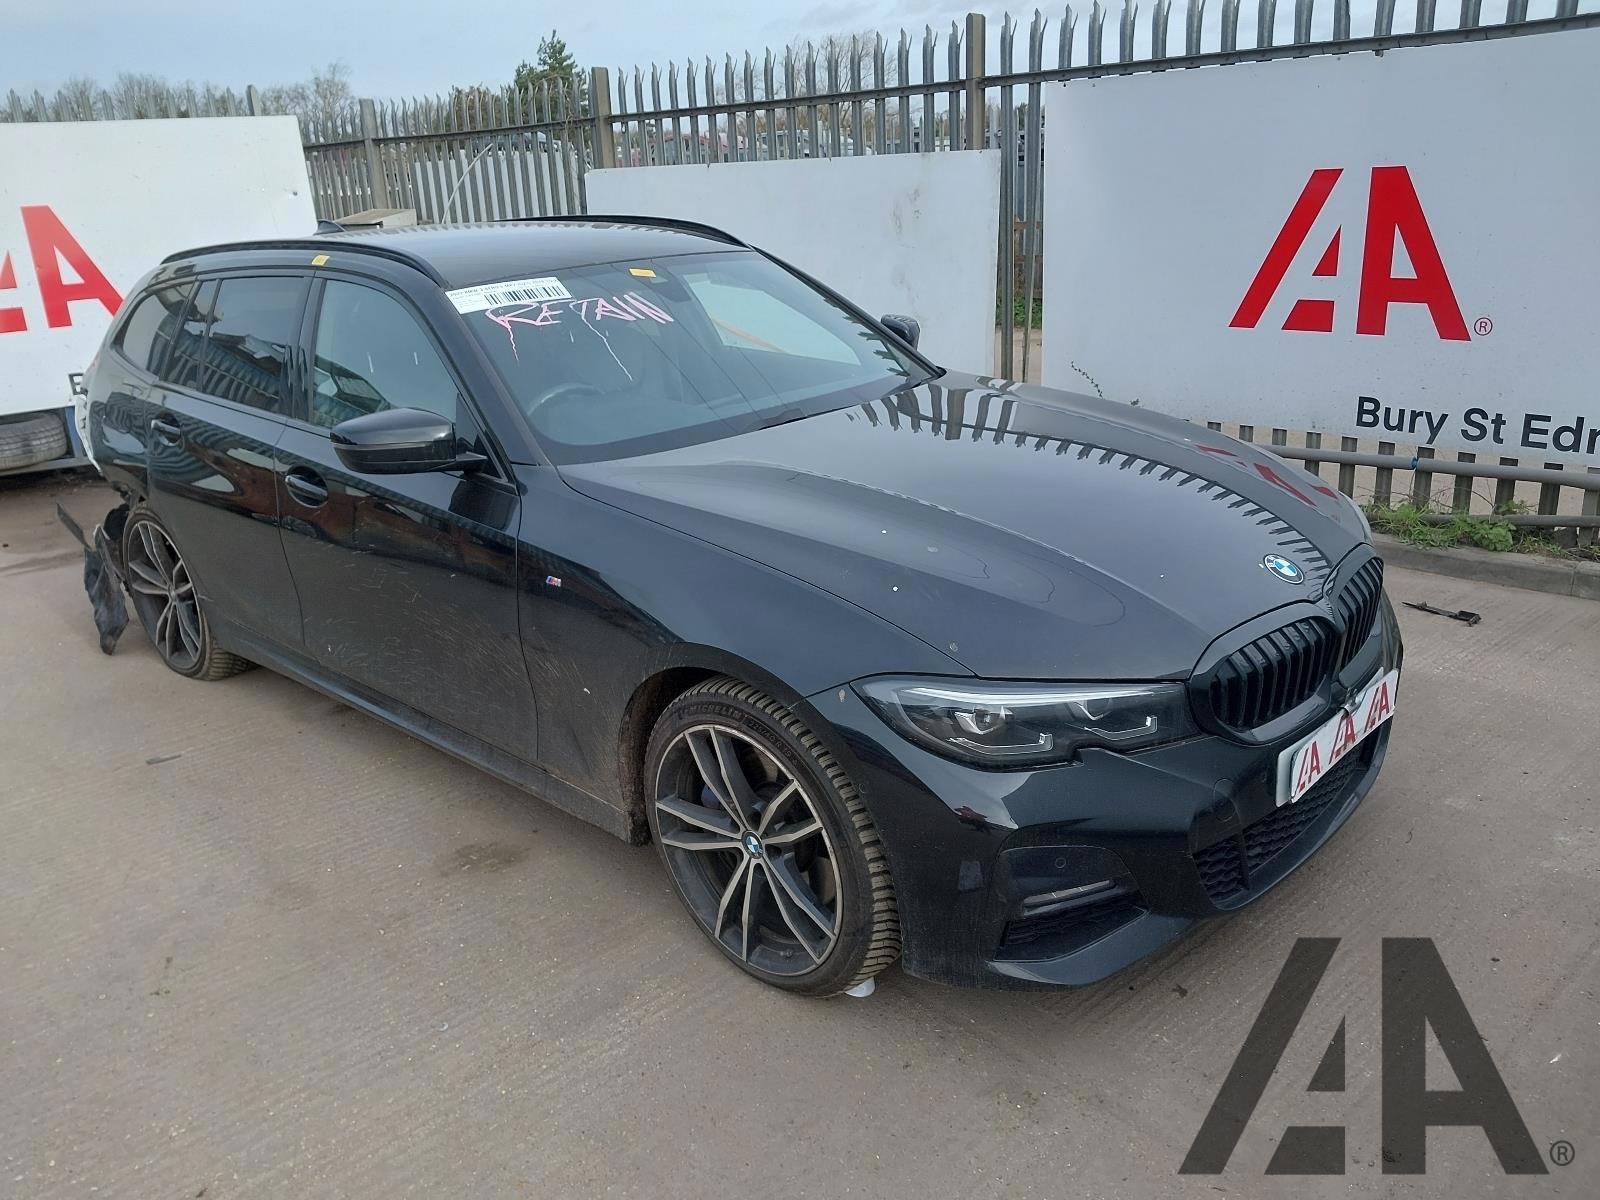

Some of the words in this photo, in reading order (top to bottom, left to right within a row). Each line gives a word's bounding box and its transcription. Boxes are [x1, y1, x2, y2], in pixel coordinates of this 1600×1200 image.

[1356, 396, 1449, 445] Bury
[1460, 408, 1507, 445] St
[688, 704, 743, 720] MICHELIN
